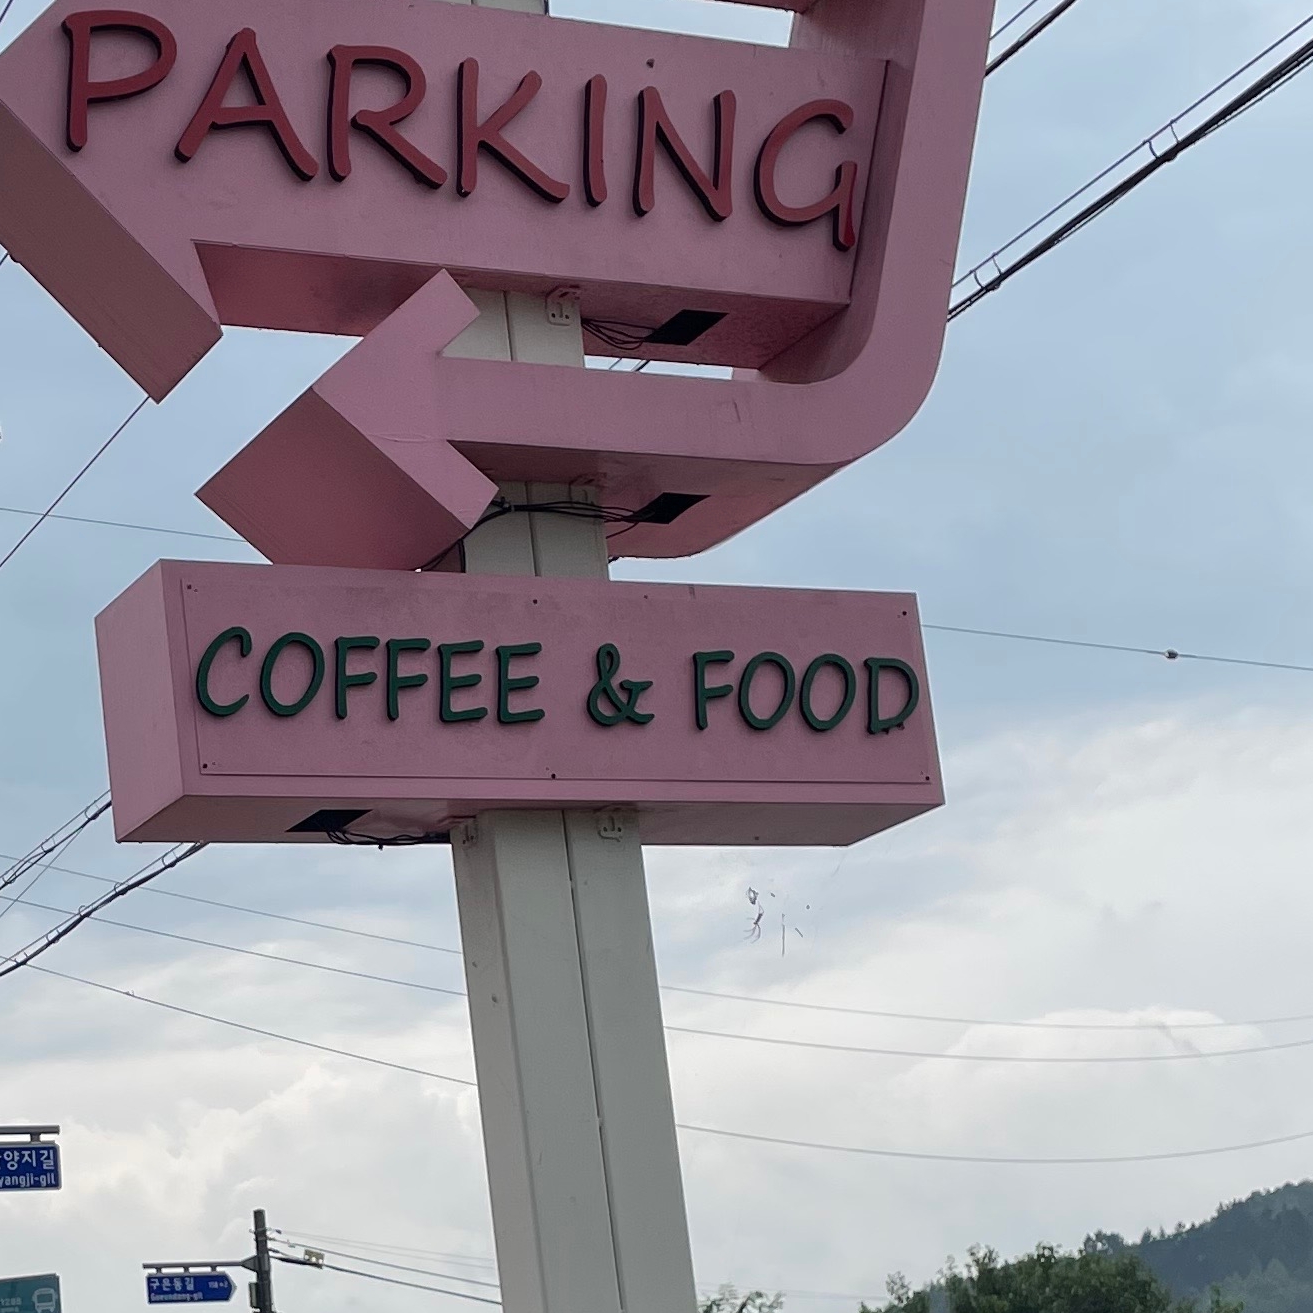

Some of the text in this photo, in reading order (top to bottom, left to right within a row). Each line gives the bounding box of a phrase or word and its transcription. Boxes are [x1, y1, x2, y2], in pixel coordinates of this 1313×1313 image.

[62, 10, 858, 251] PARKING
[195, 626, 921, 735] COFFEE & FOOD
